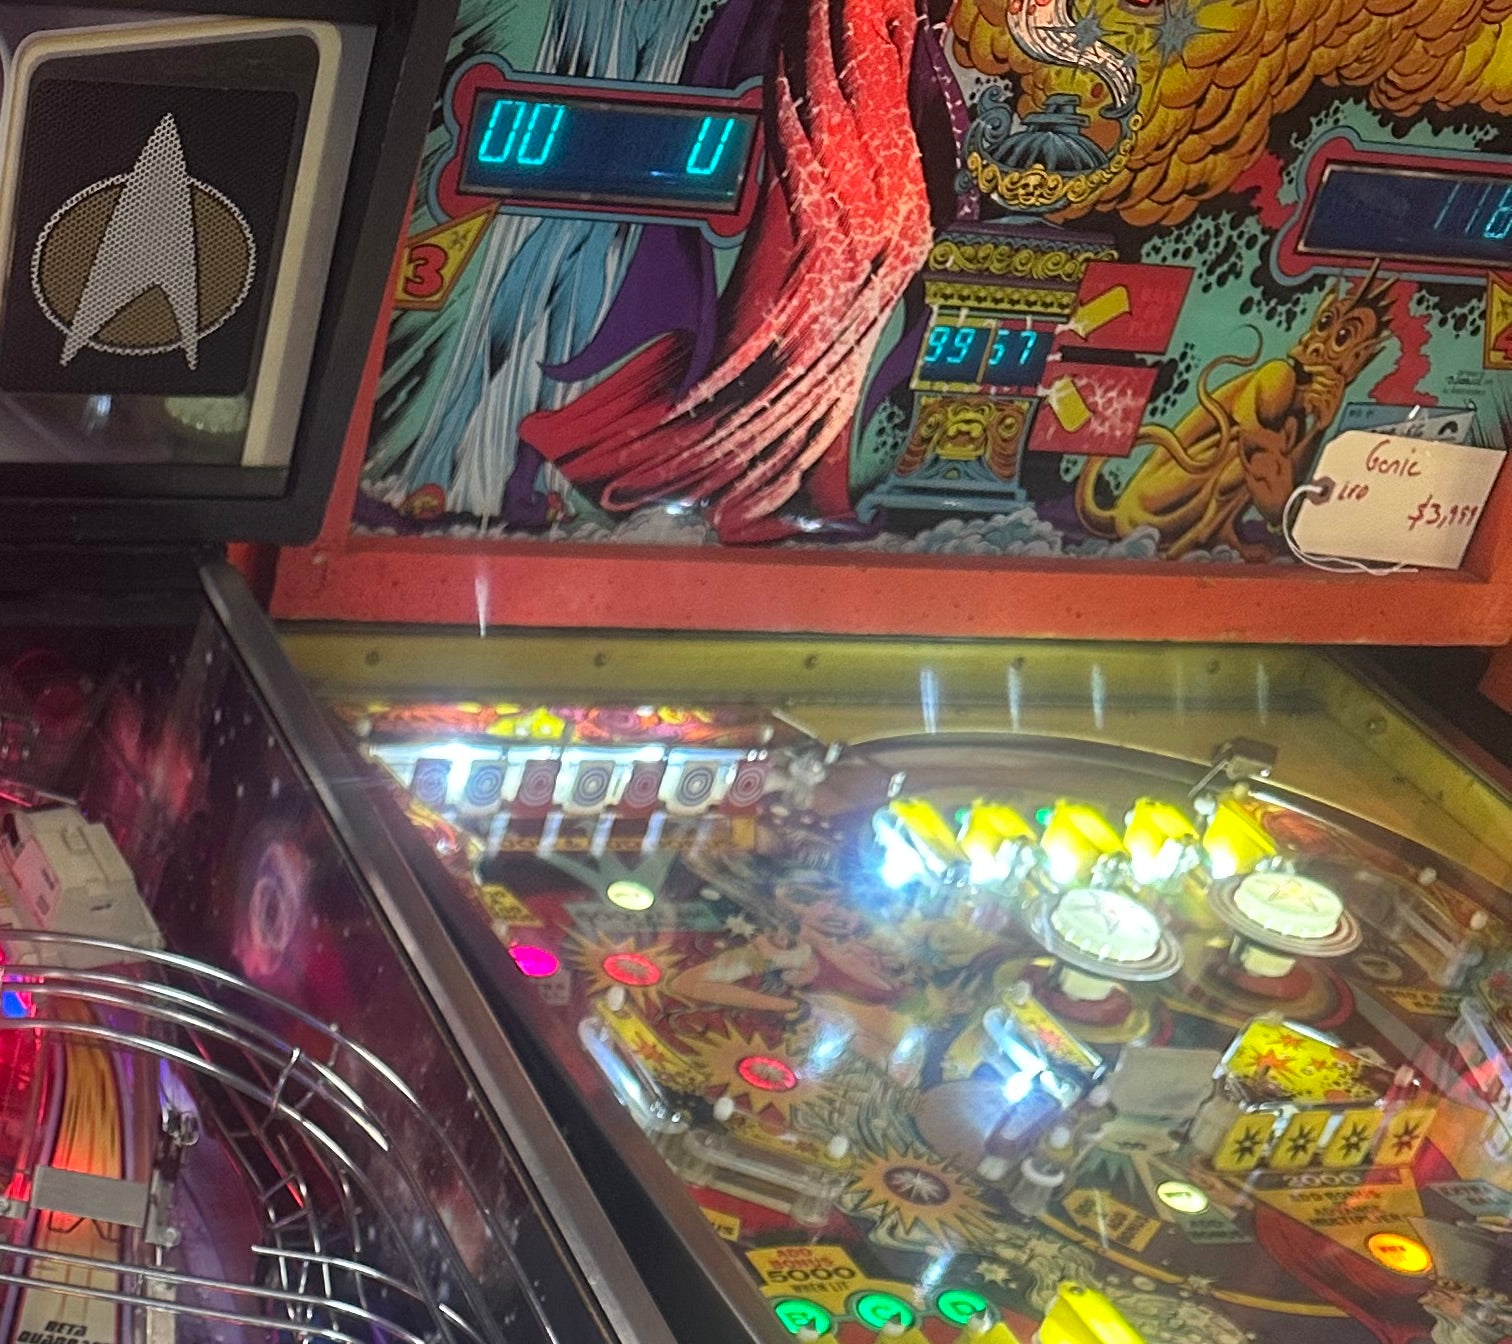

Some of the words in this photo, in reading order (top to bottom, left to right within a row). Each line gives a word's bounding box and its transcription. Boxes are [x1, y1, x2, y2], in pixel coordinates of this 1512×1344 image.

[404, 244, 449, 297] 3
[926, 325, 969, 364] 99
[767, 1266, 856, 1285] 5000
[44, 1320, 88, 1337] BETA
